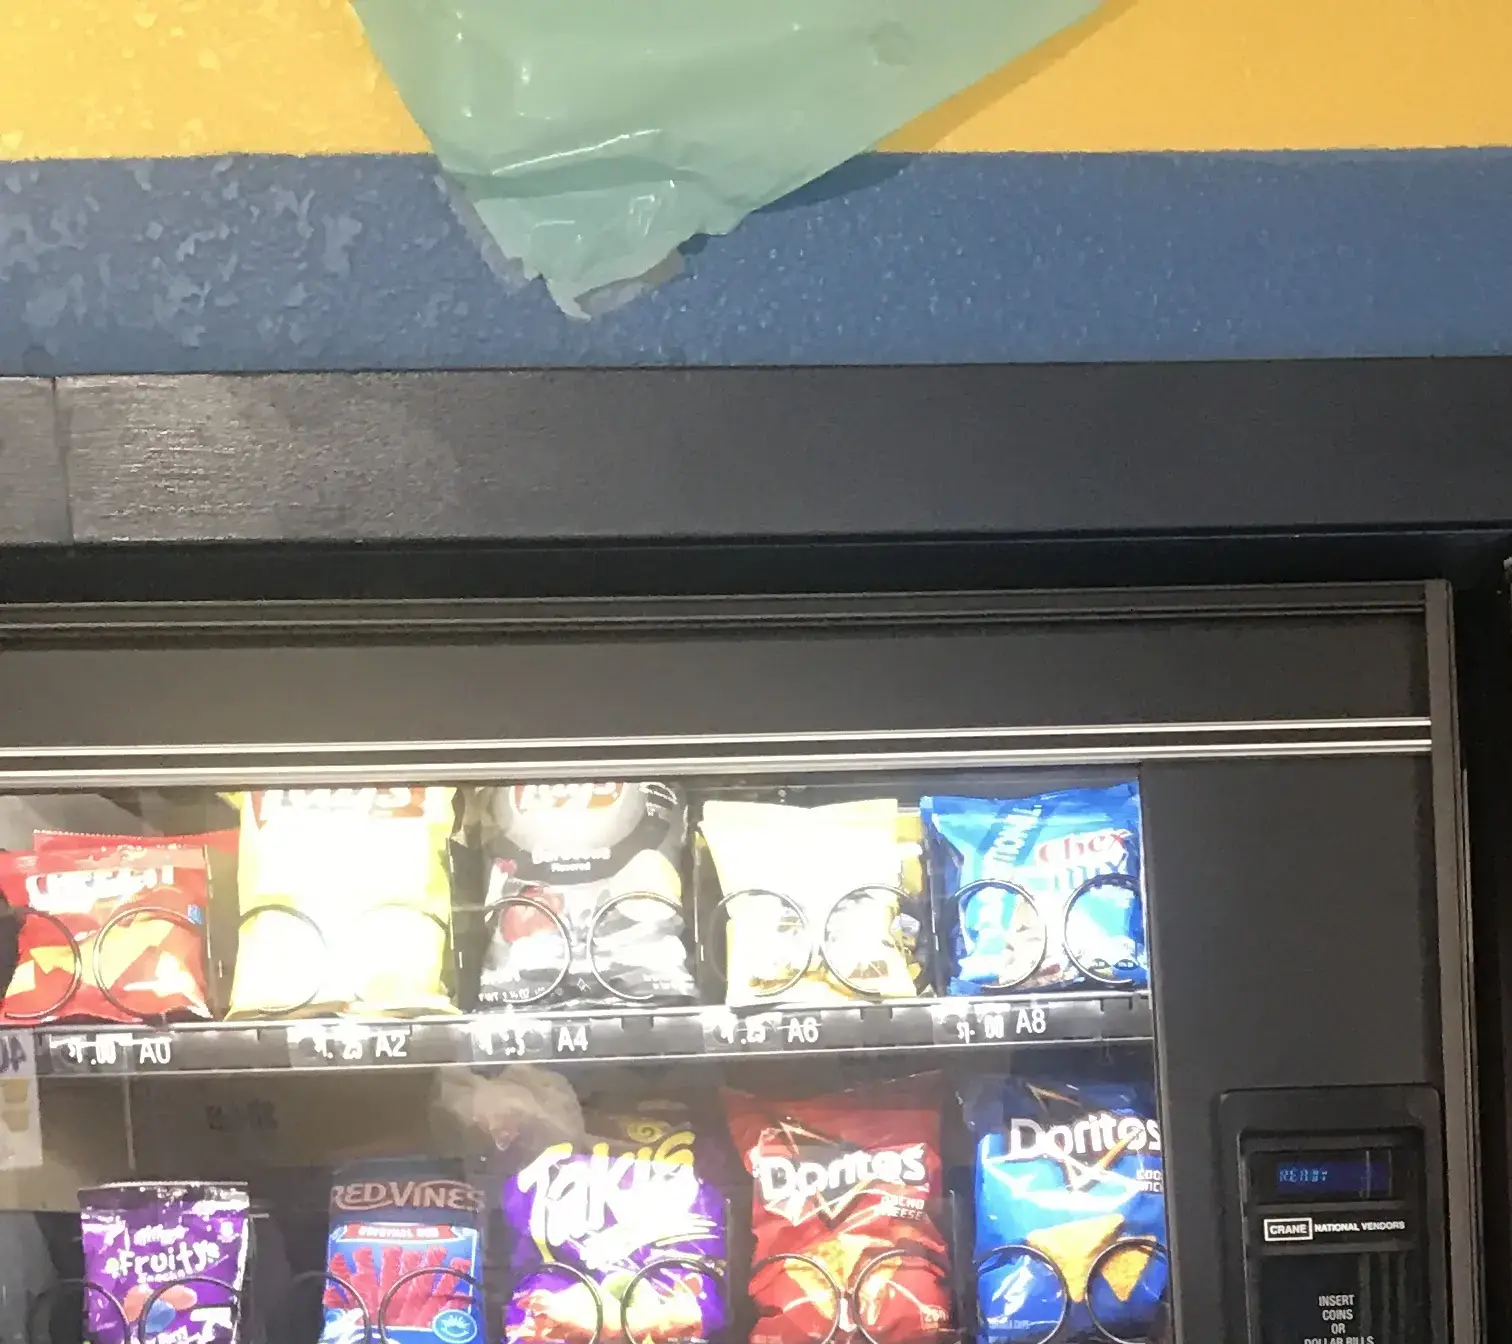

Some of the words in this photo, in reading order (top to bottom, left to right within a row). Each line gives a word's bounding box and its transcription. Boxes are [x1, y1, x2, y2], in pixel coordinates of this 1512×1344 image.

[788, 1017, 819, 1043] A6
[1015, 1008, 1047, 1035] A8
[140, 1037, 172, 1065] A0
[376, 1031, 407, 1058] A2
[557, 1026, 589, 1052] A4
[1009, 1111, 1161, 1158] Doritos
[759, 1143, 927, 1202] Doritos
[516, 1130, 701, 1264] Takis
[1269, 1223, 1307, 1235] CRANE
[1314, 1222, 1360, 1233] NATIONAL
[1361, 1220, 1405, 1231] VENDORS
[1318, 1294, 1355, 1307] INSERT
[1322, 1308, 1353, 1321] COINS
[1331, 1322, 1346, 1334] OR
